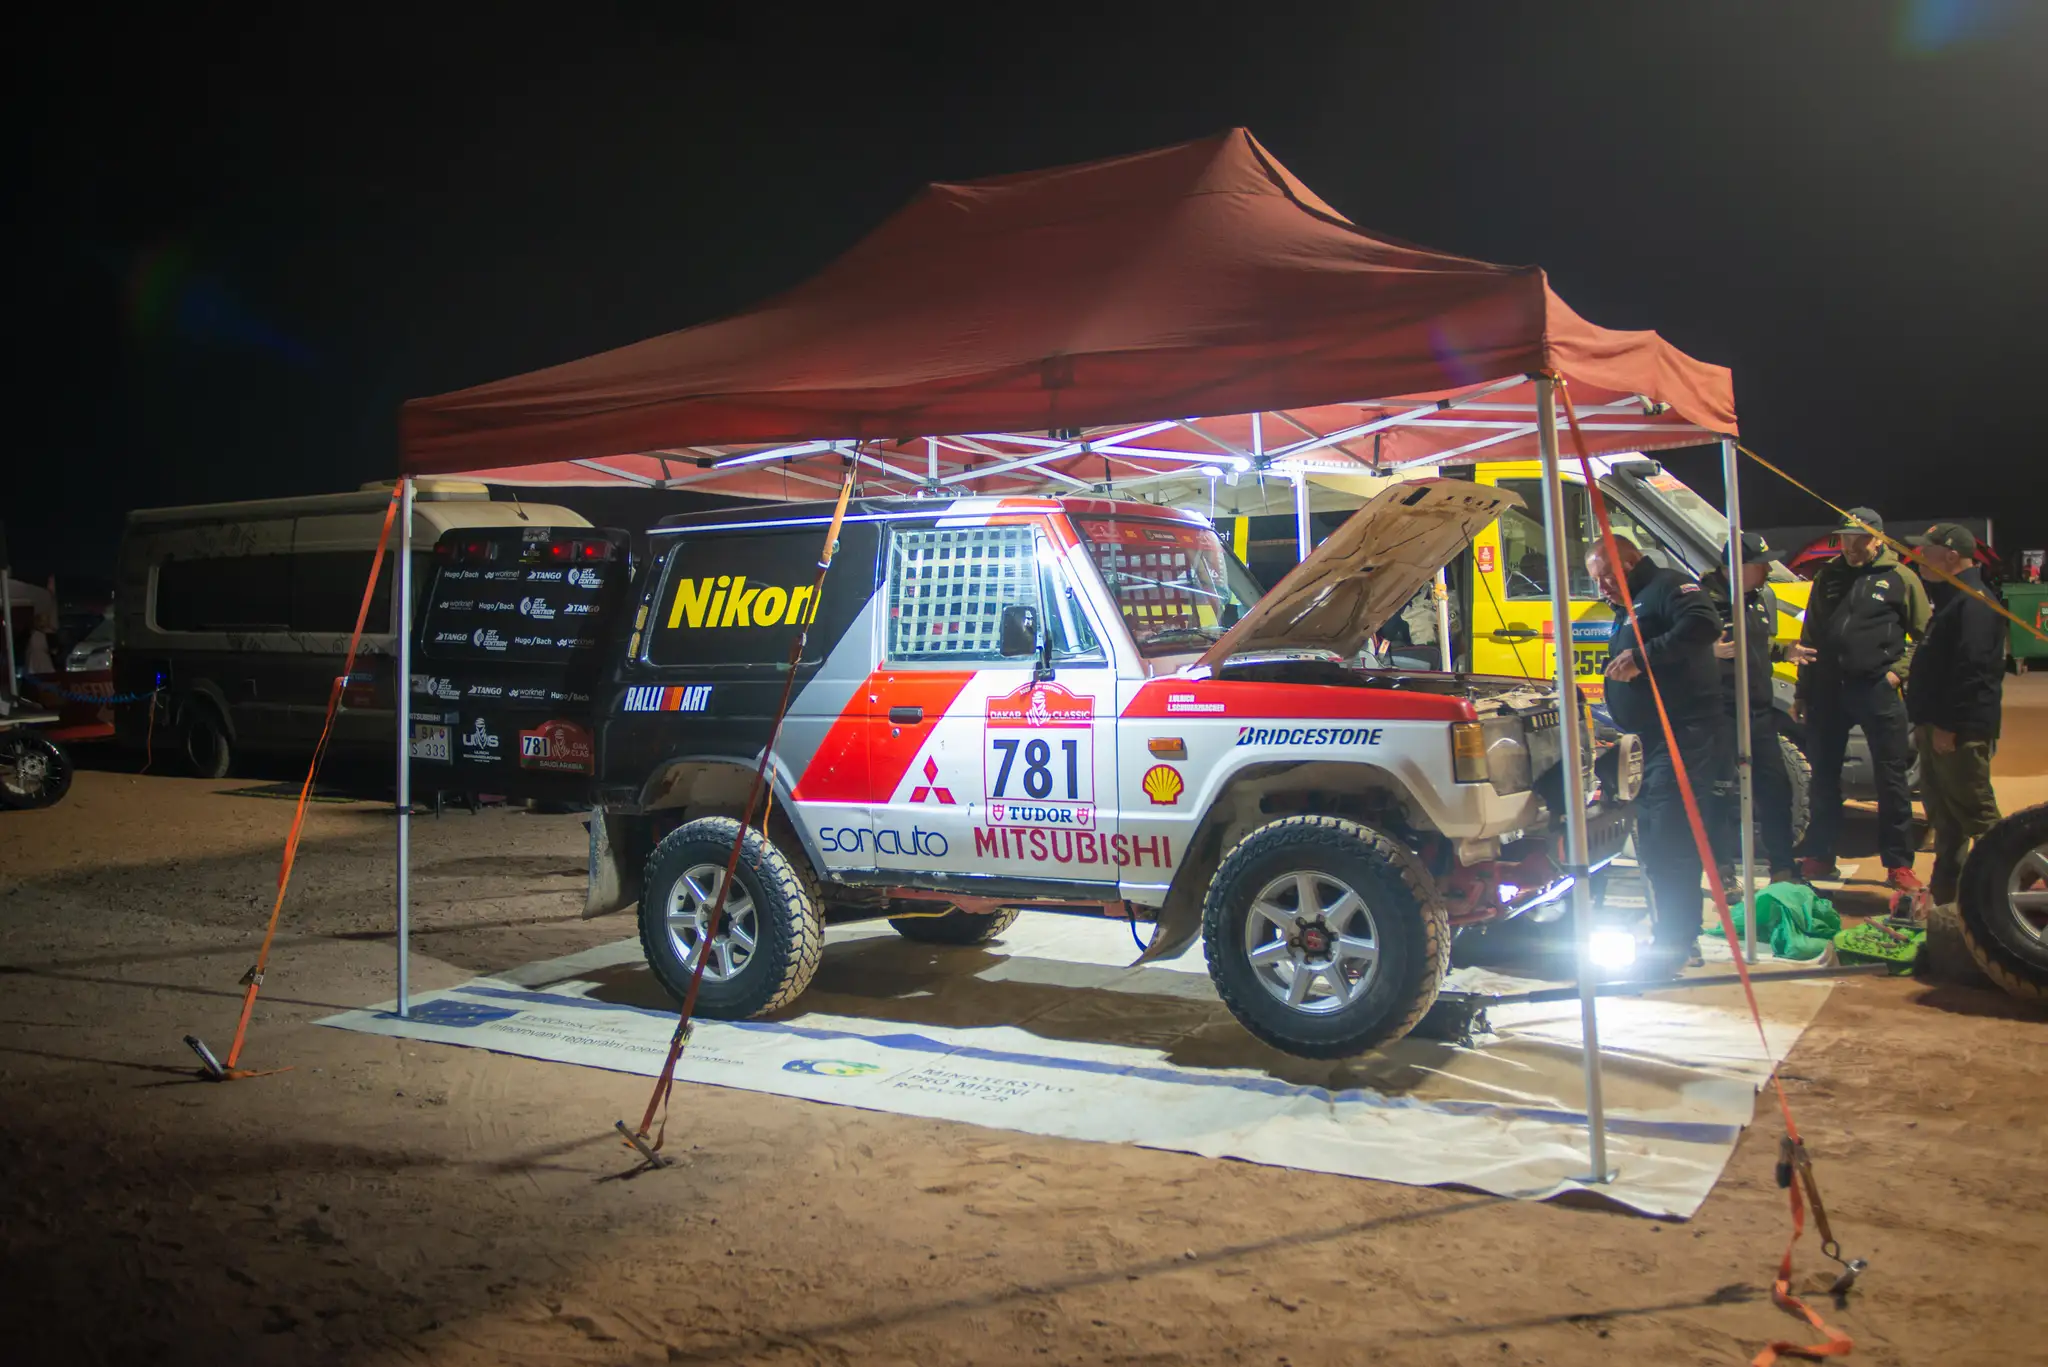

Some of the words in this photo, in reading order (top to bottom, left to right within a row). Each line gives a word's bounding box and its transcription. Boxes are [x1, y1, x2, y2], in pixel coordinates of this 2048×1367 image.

[536, 571, 562, 580] TANGO
[478, 601, 515, 611] Hugo/Bach
[573, 604, 600, 613] TANGO
[667, 575, 822, 629] Nikon
[443, 632, 468, 641] TANGO
[514, 636, 552, 646] Hugo/Bach
[476, 686, 503, 695] TANGO
[519, 688, 546, 697] worknet
[623, 686, 665, 711] RALLI
[680, 686, 712, 711] ART
[989, 710, 1022, 720] DAKAR
[1052, 711, 1090, 720] CLASSIC
[1236, 727, 1383, 746] BRIDGESTONE
[524, 736, 548, 756] 781
[993, 738, 1079, 799] 781
[1009, 806, 1073, 823] TUDOR
[820, 825, 949, 857] sonauto
[973, 826, 1173, 869] MITSUBISHI
[907, 1074, 950, 1086] PRO
[921, 1068, 1075, 1094] MINISTERSTVO
